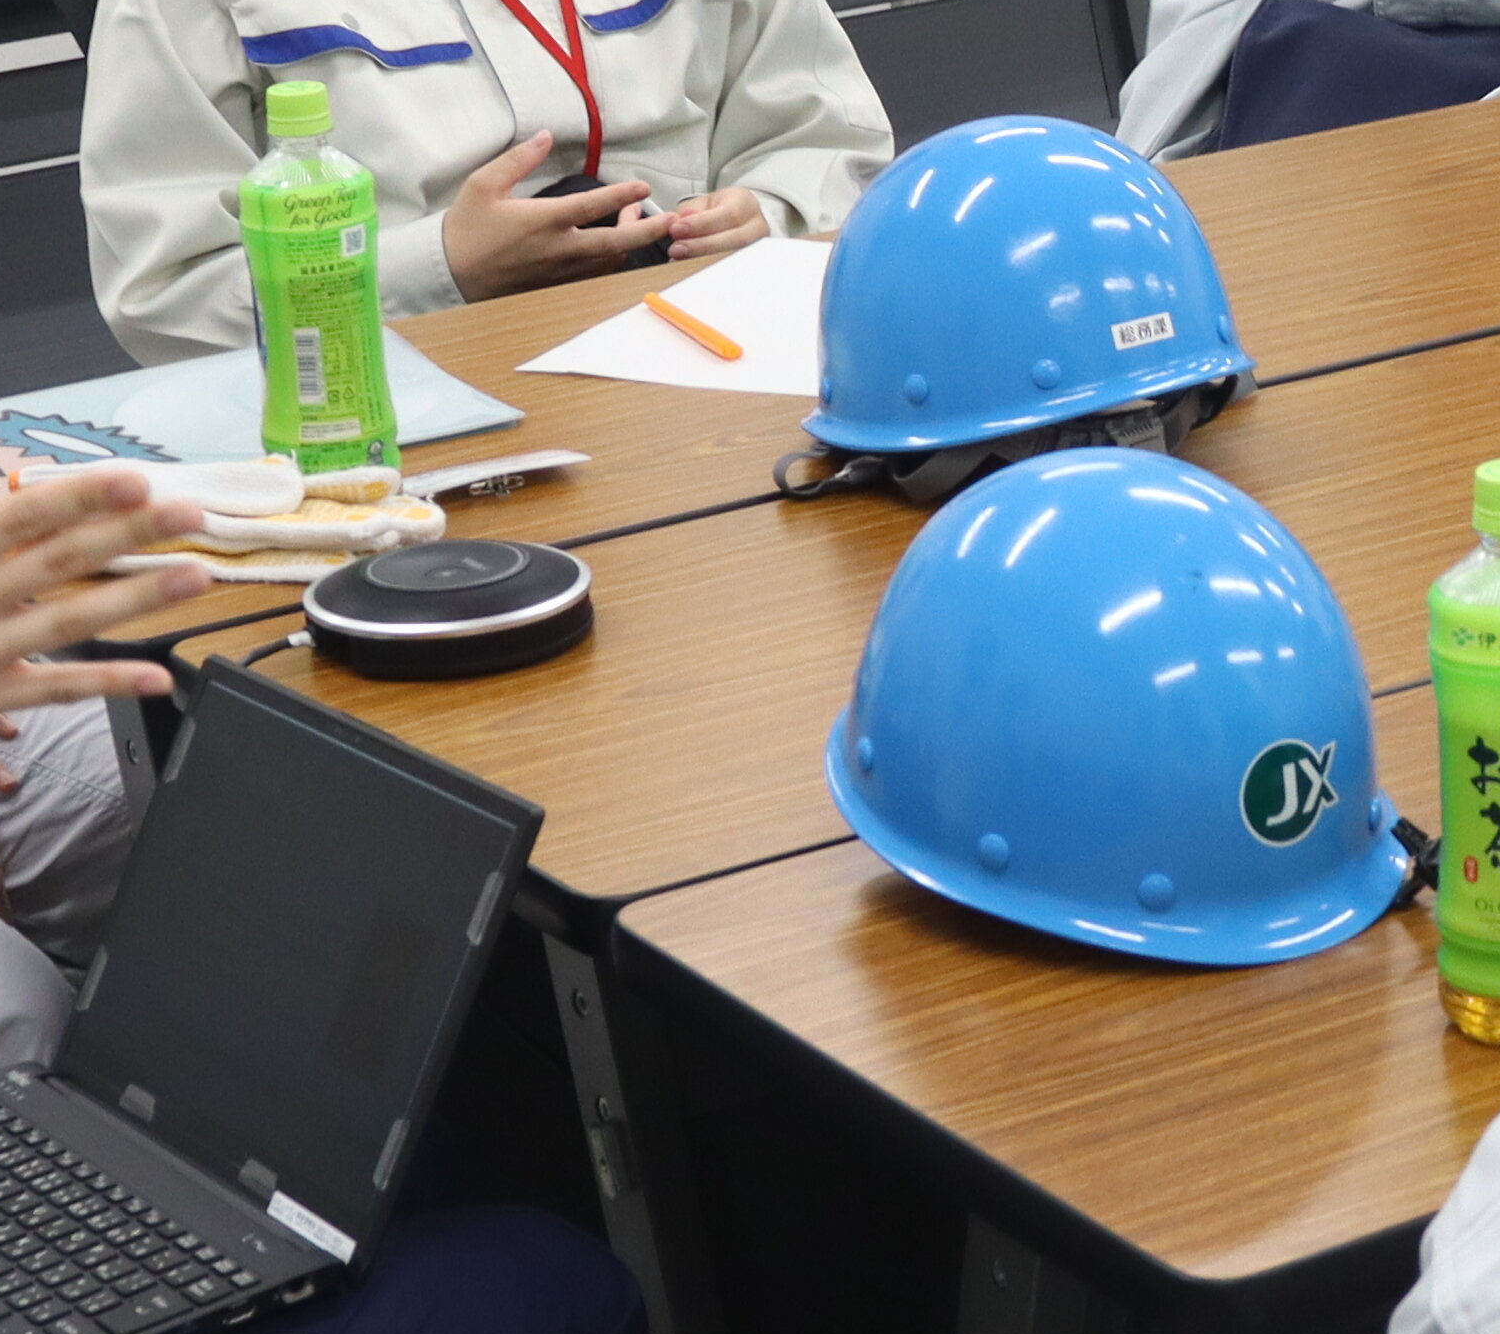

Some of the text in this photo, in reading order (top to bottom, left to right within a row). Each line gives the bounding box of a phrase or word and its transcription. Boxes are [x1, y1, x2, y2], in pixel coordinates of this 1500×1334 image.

[283, 183, 358, 215] Green Tea
[313, 202, 353, 229] Good
[1265, 739, 1340, 828] JX
[1474, 897, 1494, 914] Oi
